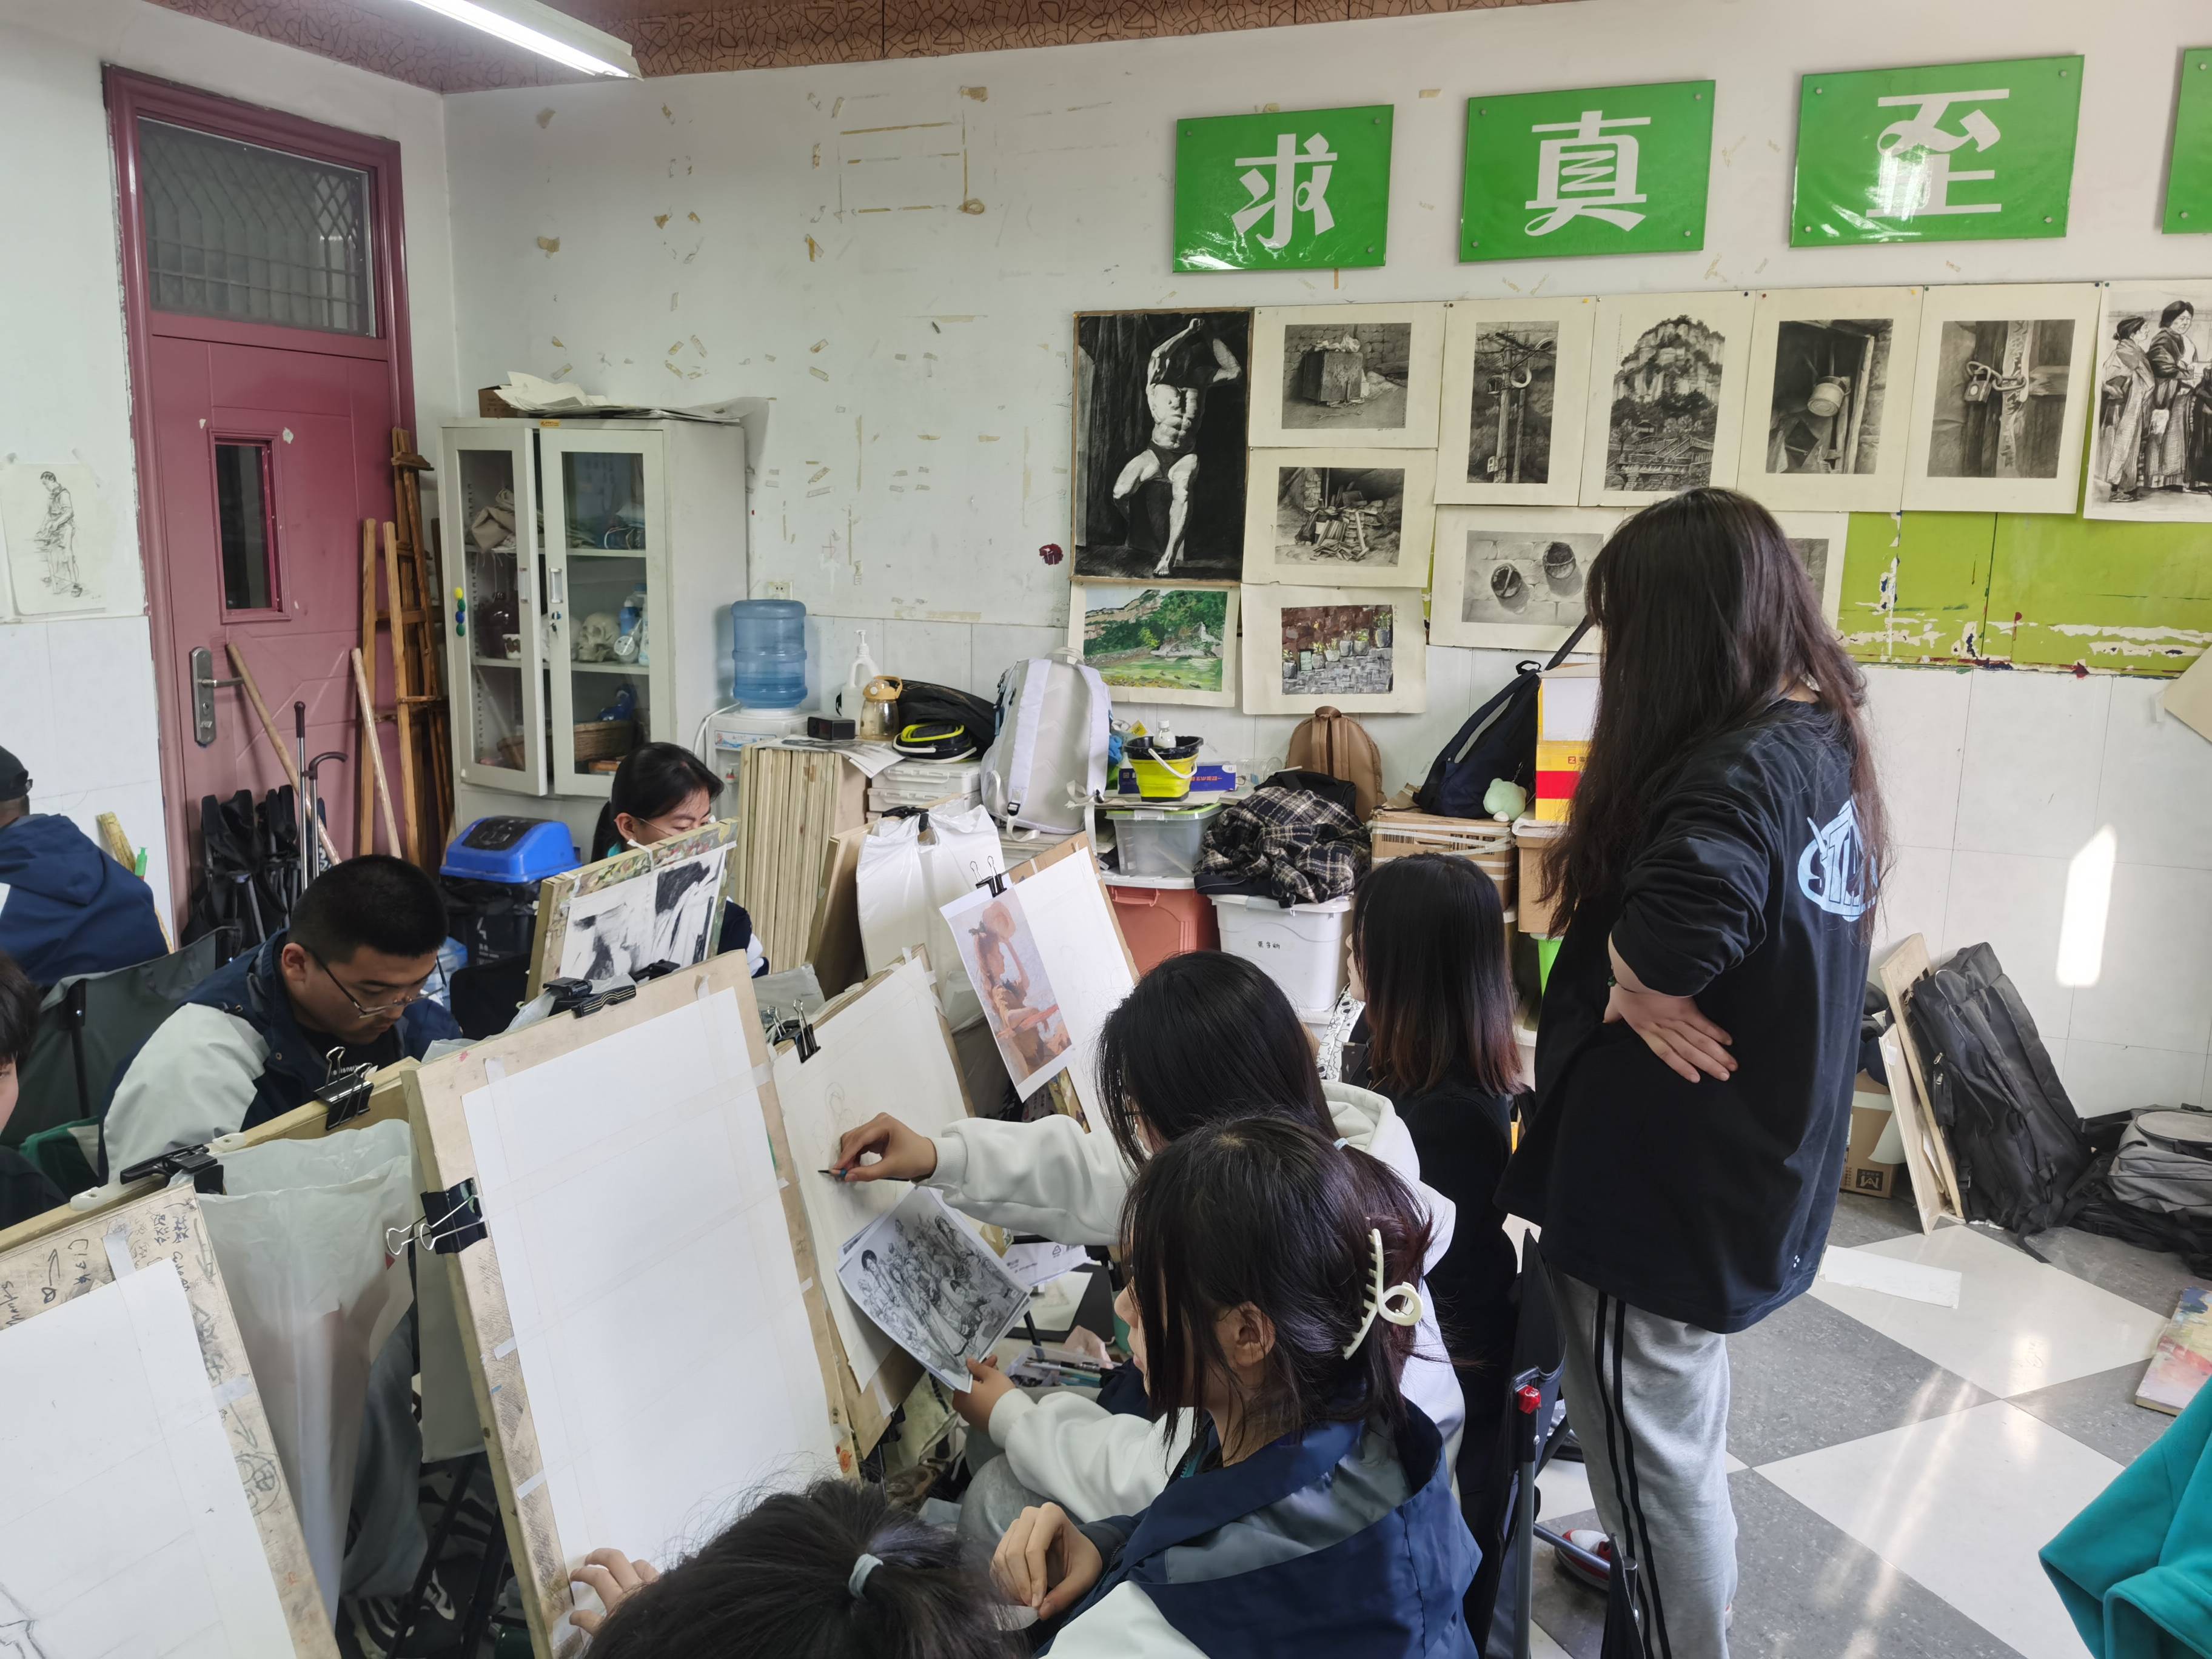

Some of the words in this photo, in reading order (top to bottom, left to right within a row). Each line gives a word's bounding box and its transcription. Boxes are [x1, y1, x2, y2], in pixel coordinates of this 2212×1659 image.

[1232, 132, 1338, 249] 求
[1524, 110, 1651, 236] 真
[1866, 89, 2009, 218] 至
